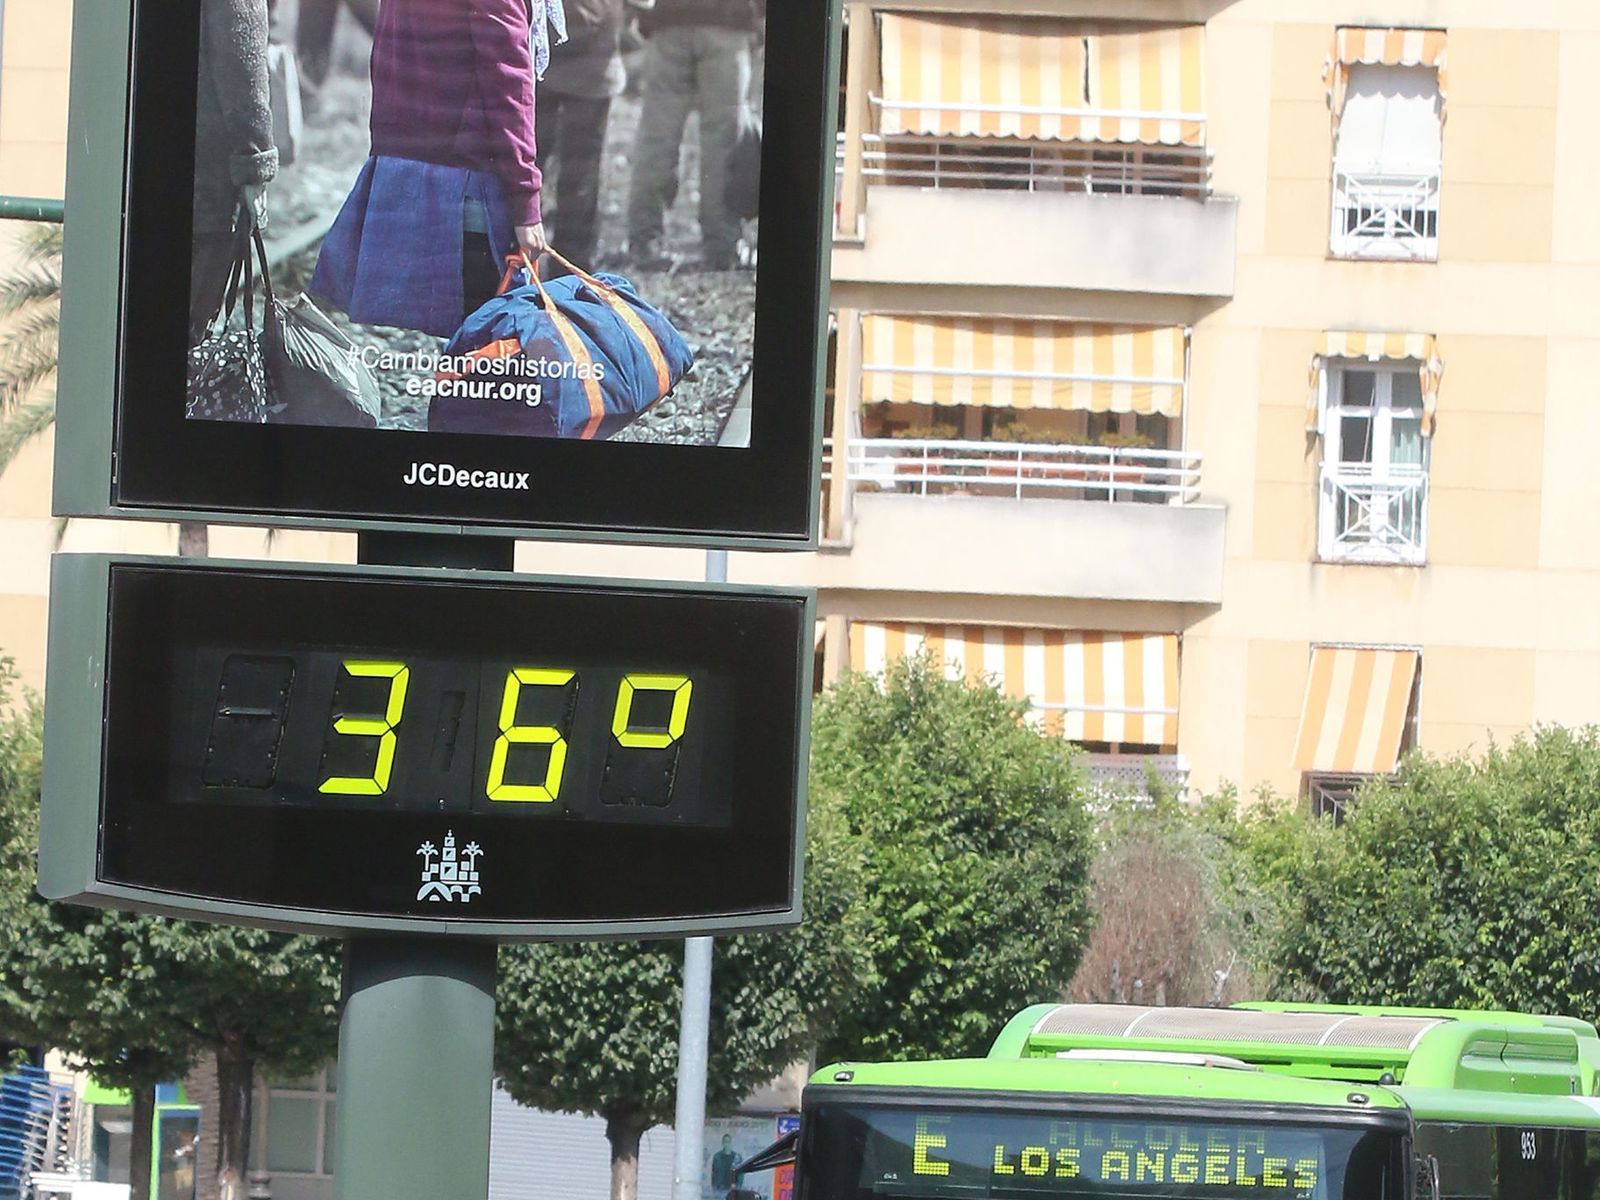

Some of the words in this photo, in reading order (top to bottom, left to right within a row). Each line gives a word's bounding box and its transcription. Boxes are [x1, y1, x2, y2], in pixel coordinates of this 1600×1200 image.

[347, 345, 605, 380] #Cambiamoshistorias
[406, 375, 542, 406] eacnur.org
[403, 462, 530, 489] JCDecaux
[913, 1115, 951, 1176] E
[993, 1144, 1081, 1178] LOS
[1100, 1149, 1319, 1189] ANGELES
[1521, 1132, 1536, 1160] 953
